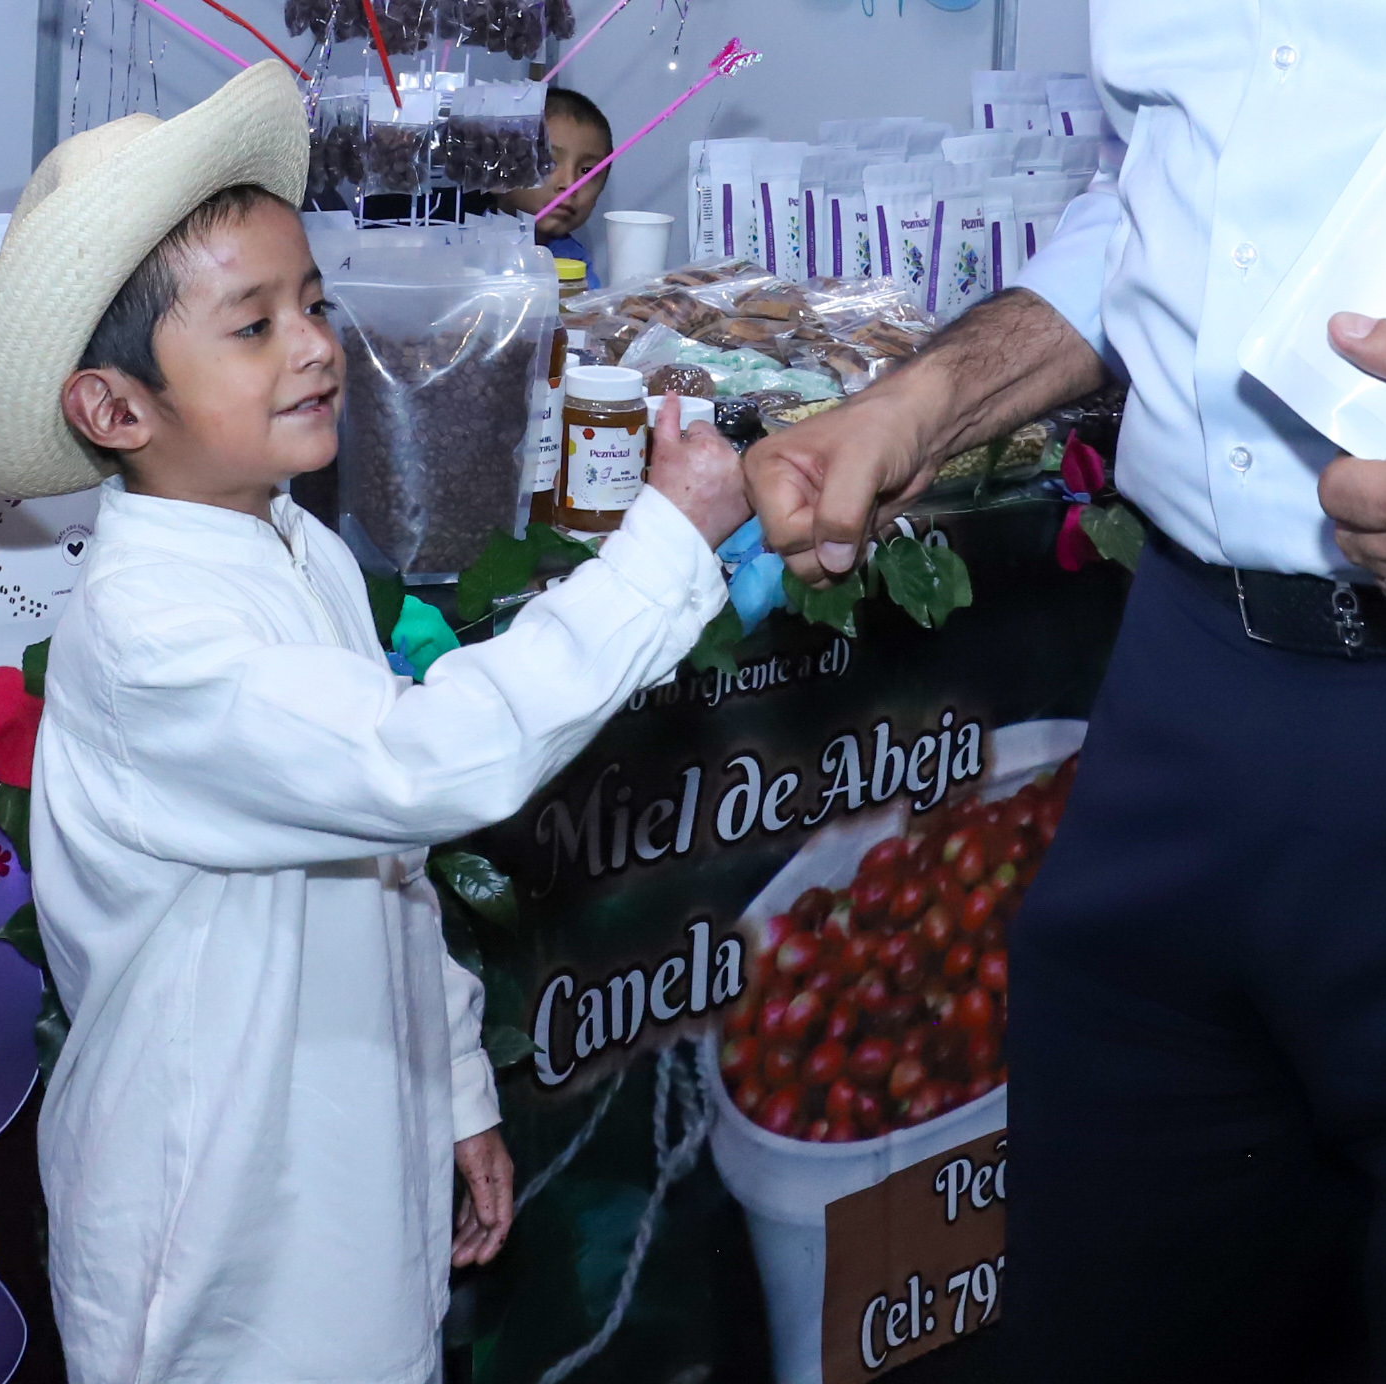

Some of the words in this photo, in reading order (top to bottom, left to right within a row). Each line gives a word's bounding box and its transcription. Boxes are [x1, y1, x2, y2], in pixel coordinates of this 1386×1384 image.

[531, 763, 701, 899] Miel
[717, 756, 798, 841] de
[804, 712, 981, 826] Abeja
[534, 922, 743, 1086] Canela
[862, 1276, 935, 1369] Cel:
[948, 1256, 1005, 1335] 79
